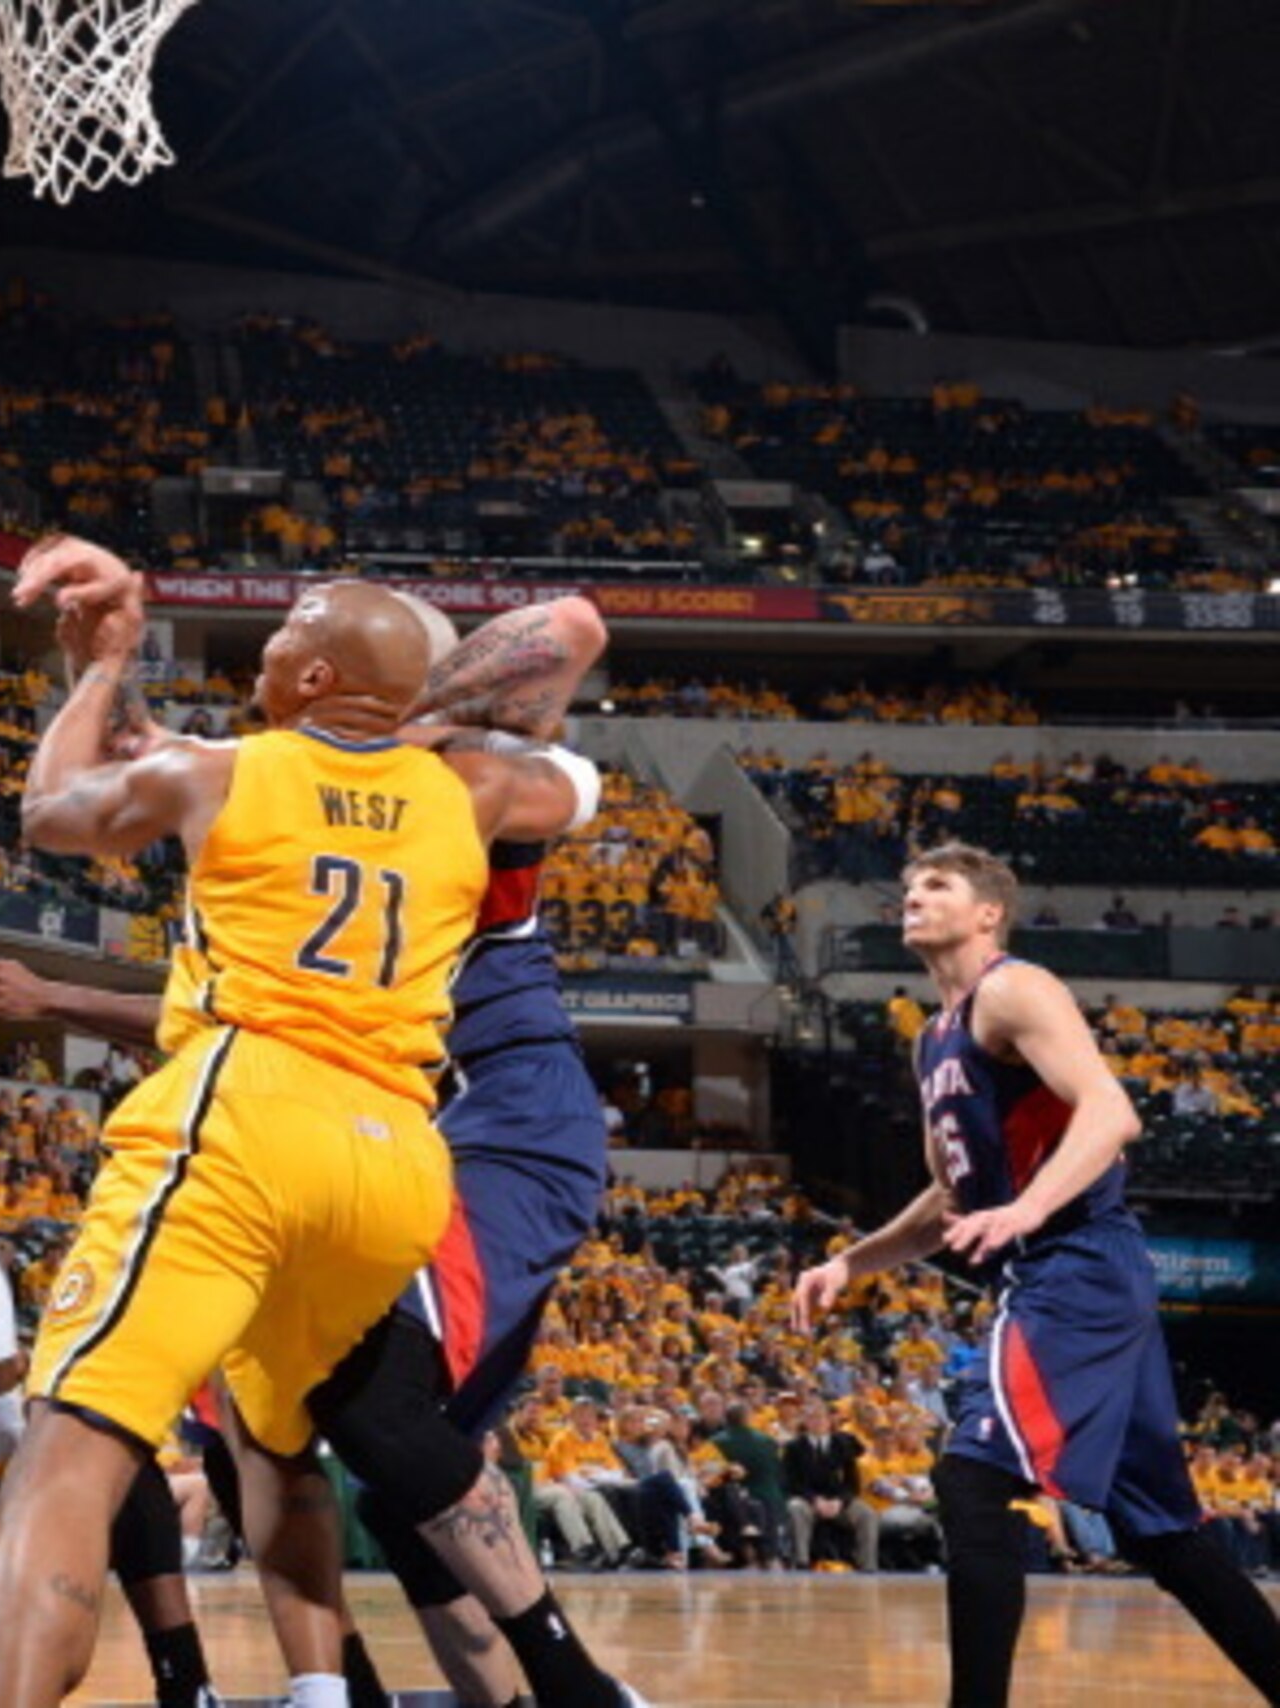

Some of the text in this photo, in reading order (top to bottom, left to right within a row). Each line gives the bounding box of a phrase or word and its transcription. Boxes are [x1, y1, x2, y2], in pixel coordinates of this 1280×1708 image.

[154, 577, 234, 598] WHEN
[240, 578, 291, 600] THE
[490, 584, 529, 606] 90
[595, 588, 652, 611] YOU
[316, 783, 410, 832] WEST
[296, 854, 405, 988] 21
